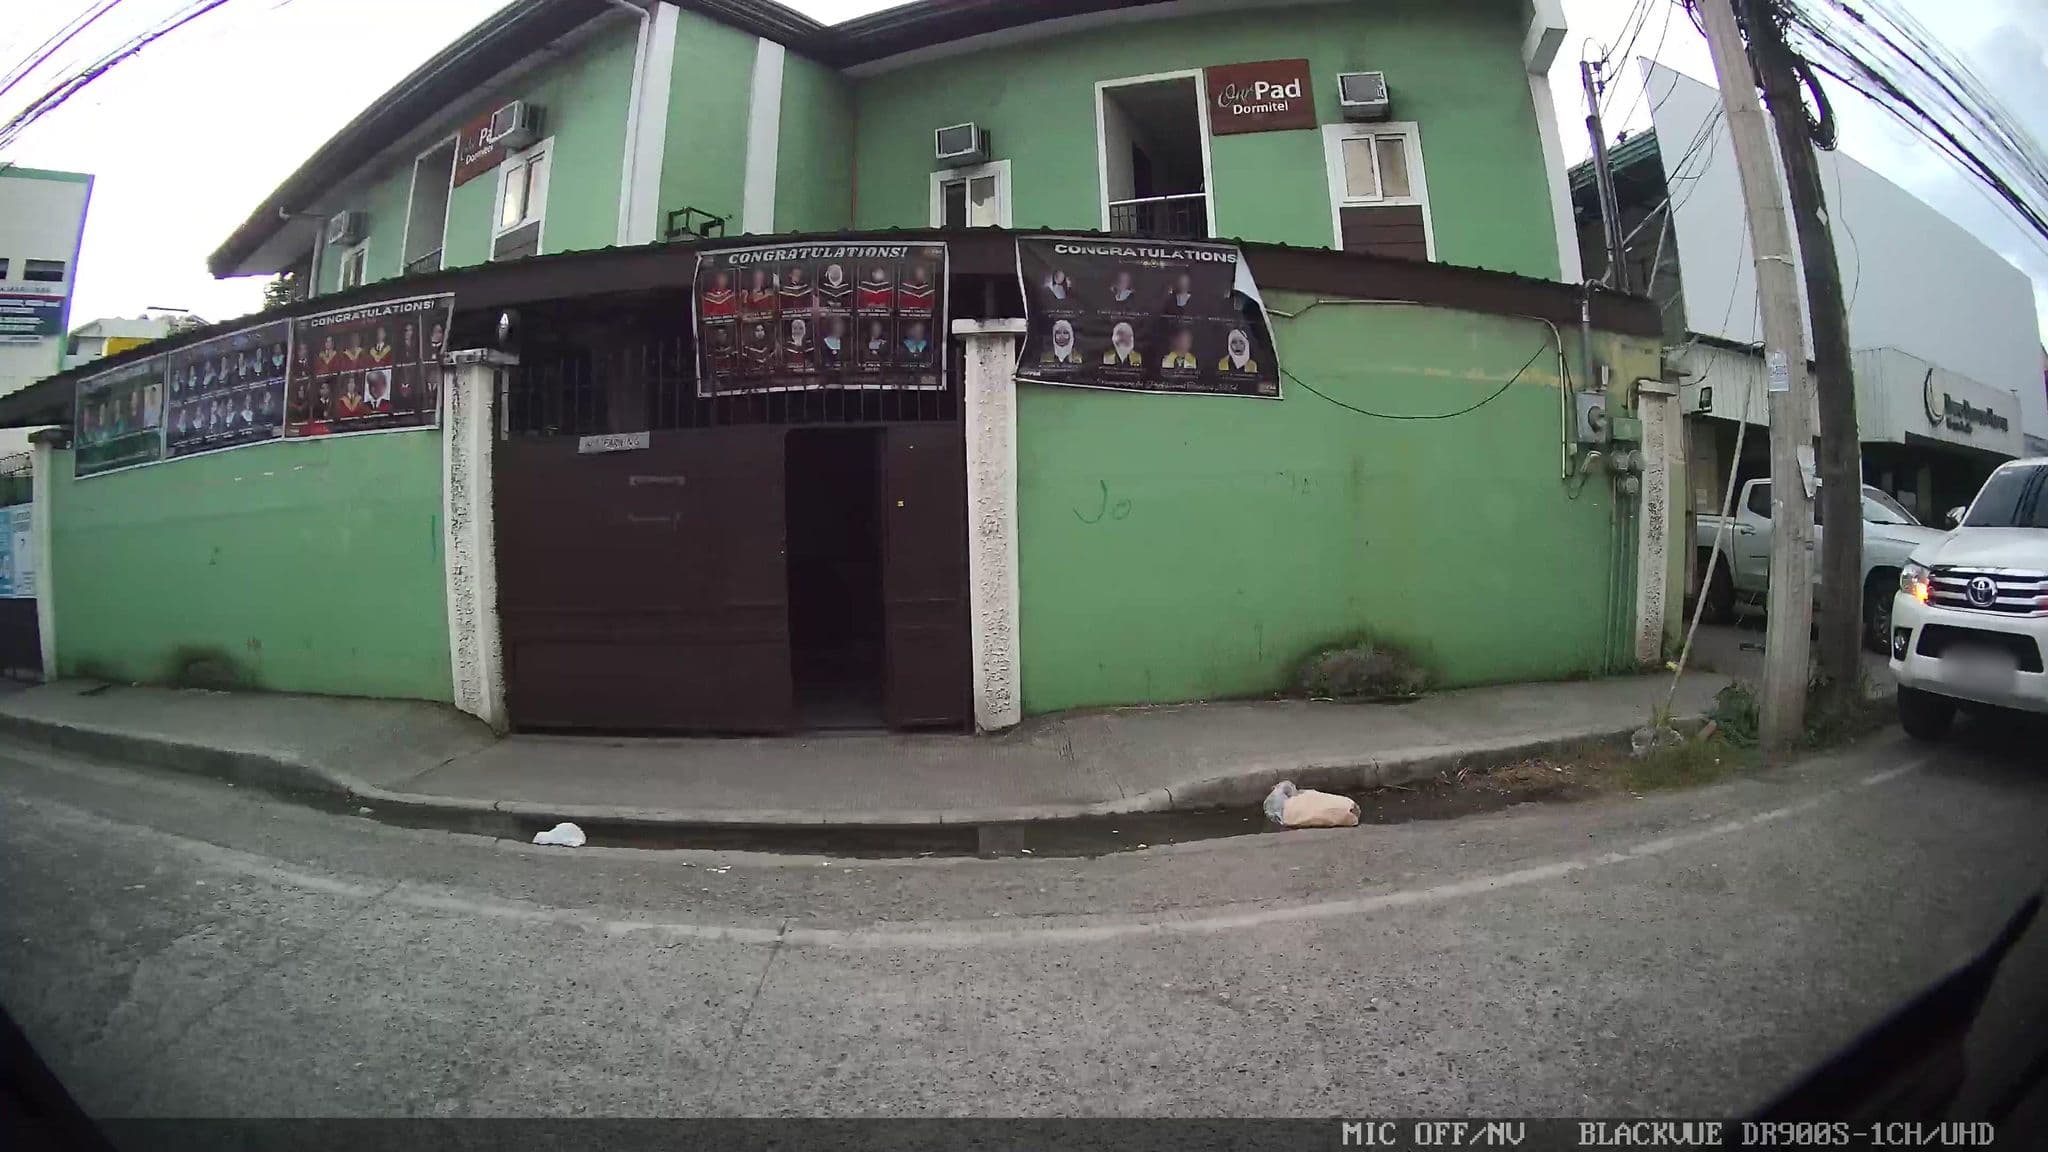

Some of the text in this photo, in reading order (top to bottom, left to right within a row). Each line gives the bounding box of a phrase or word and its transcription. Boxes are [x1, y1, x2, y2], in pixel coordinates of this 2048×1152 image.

[1254, 78, 1302, 101] Pad
[1233, 100, 1289, 115] Dormitel
[728, 246, 909, 265] CONGRATULATIONS!
[311, 300, 435, 328] CONGRATULATIONS!
